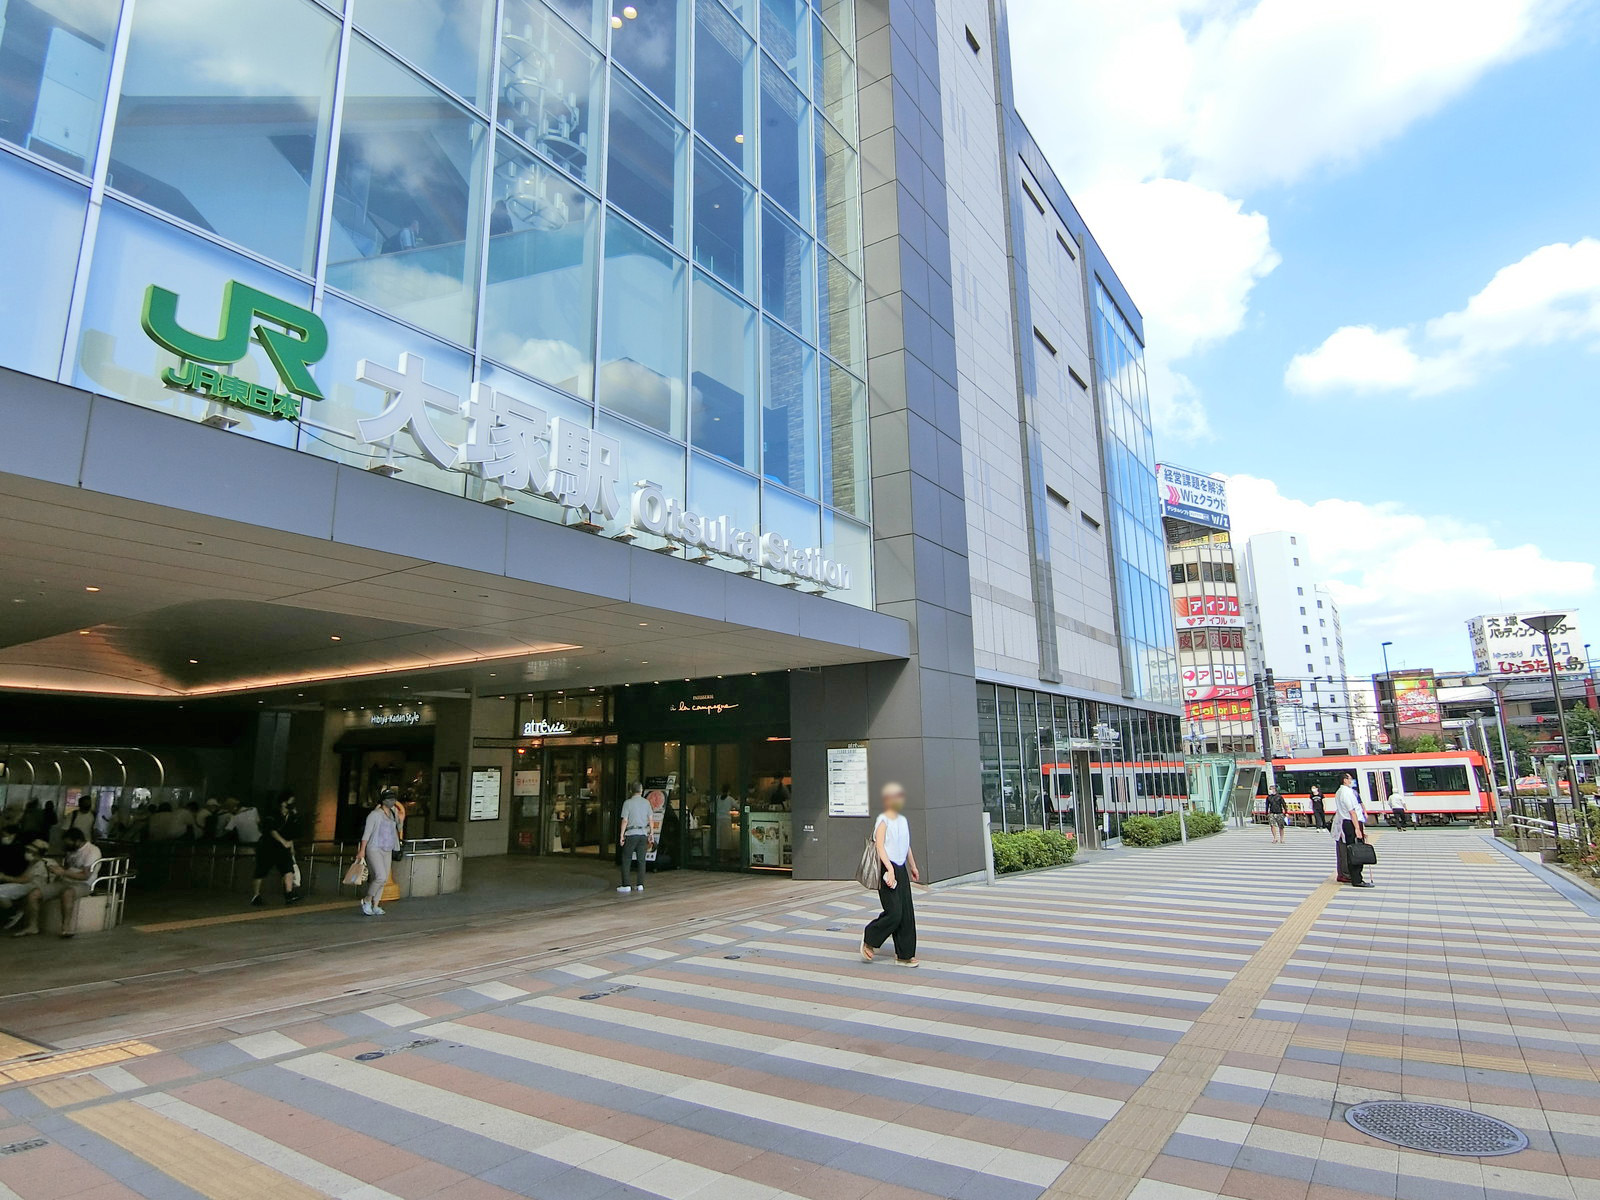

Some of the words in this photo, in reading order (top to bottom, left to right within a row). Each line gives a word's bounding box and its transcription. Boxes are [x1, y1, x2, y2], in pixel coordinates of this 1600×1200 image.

[141, 279, 328, 401] JR
[161, 362, 300, 419] JR東日本
[356, 352, 621, 520] 大塚駅
[1164, 468, 1225, 497] 経営課題を解決
[1181, 488, 1226, 512] Wizクラウド
[631, 480, 757, 562] Ōtsuka
[762, 532, 853, 591] Station
[1190, 600, 1237, 612] アイフル
[1197, 616, 1228, 626] アイフル
[1487, 615, 1518, 628] 大塚
[1489, 624, 1577, 639] バッティングンター
[1198, 670, 1235, 681] アコム
[1216, 687, 1239, 697] アコム
